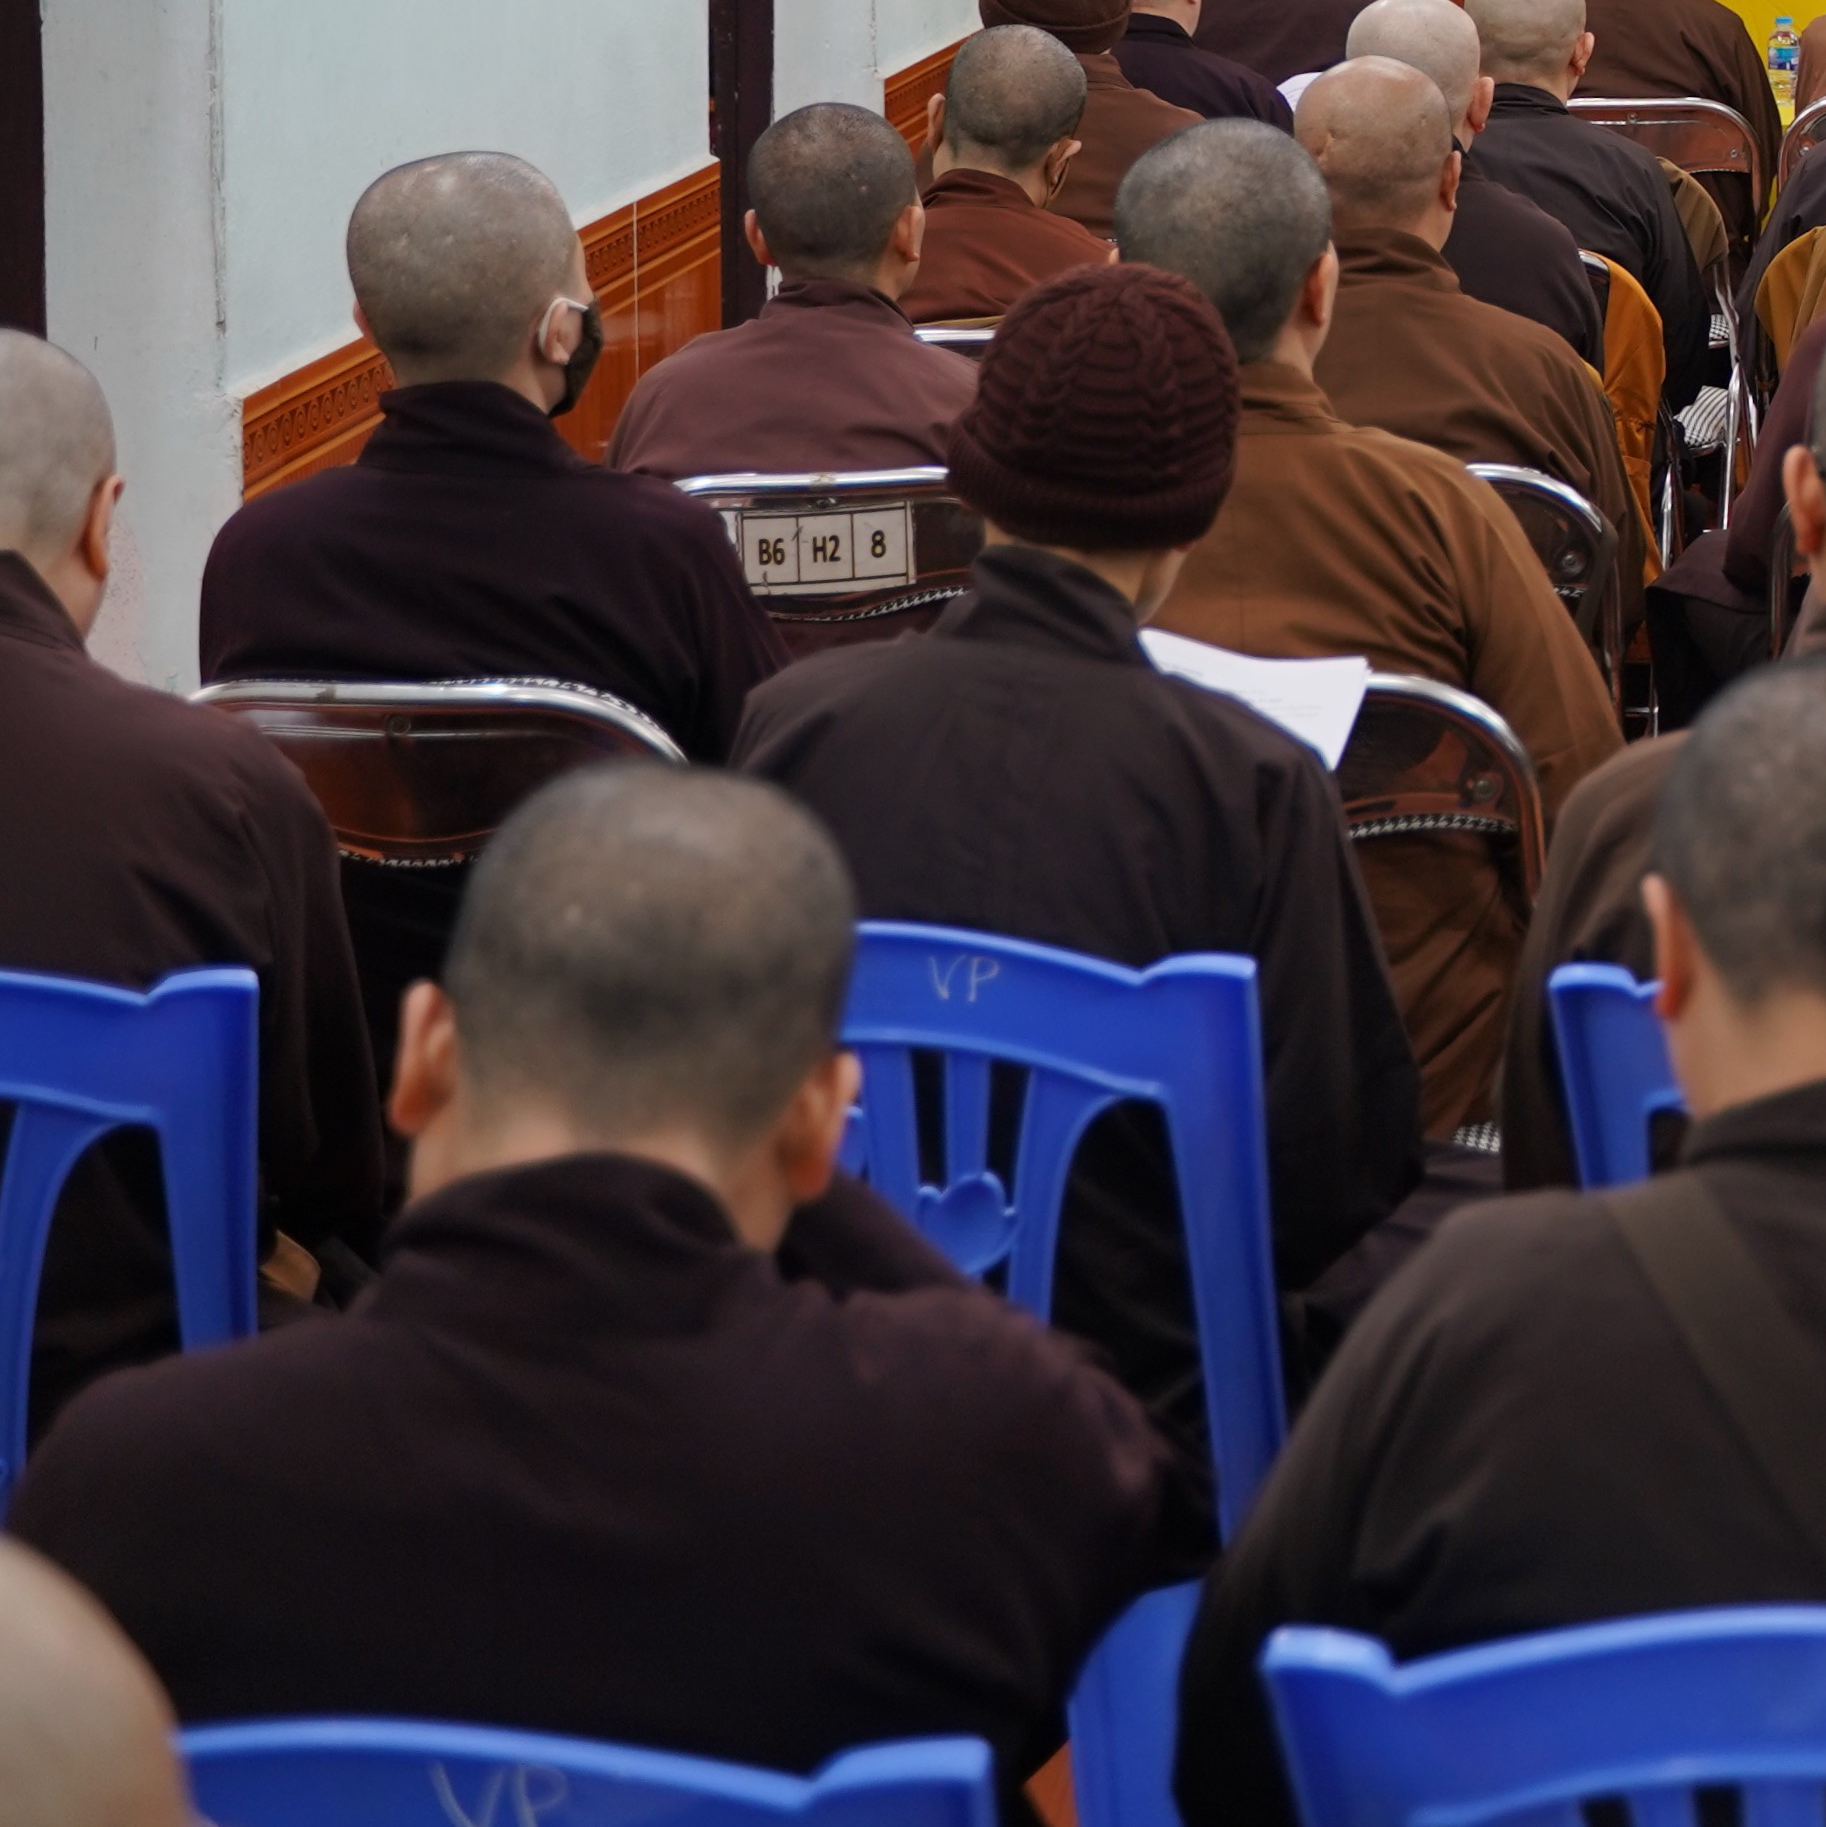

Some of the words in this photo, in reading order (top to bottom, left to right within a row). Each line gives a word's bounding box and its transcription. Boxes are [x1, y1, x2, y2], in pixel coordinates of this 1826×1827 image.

[758, 538, 785, 565] B6
[812, 535, 841, 563] H2
[871, 529, 886, 558] 8
[929, 954, 1001, 1002] VP
